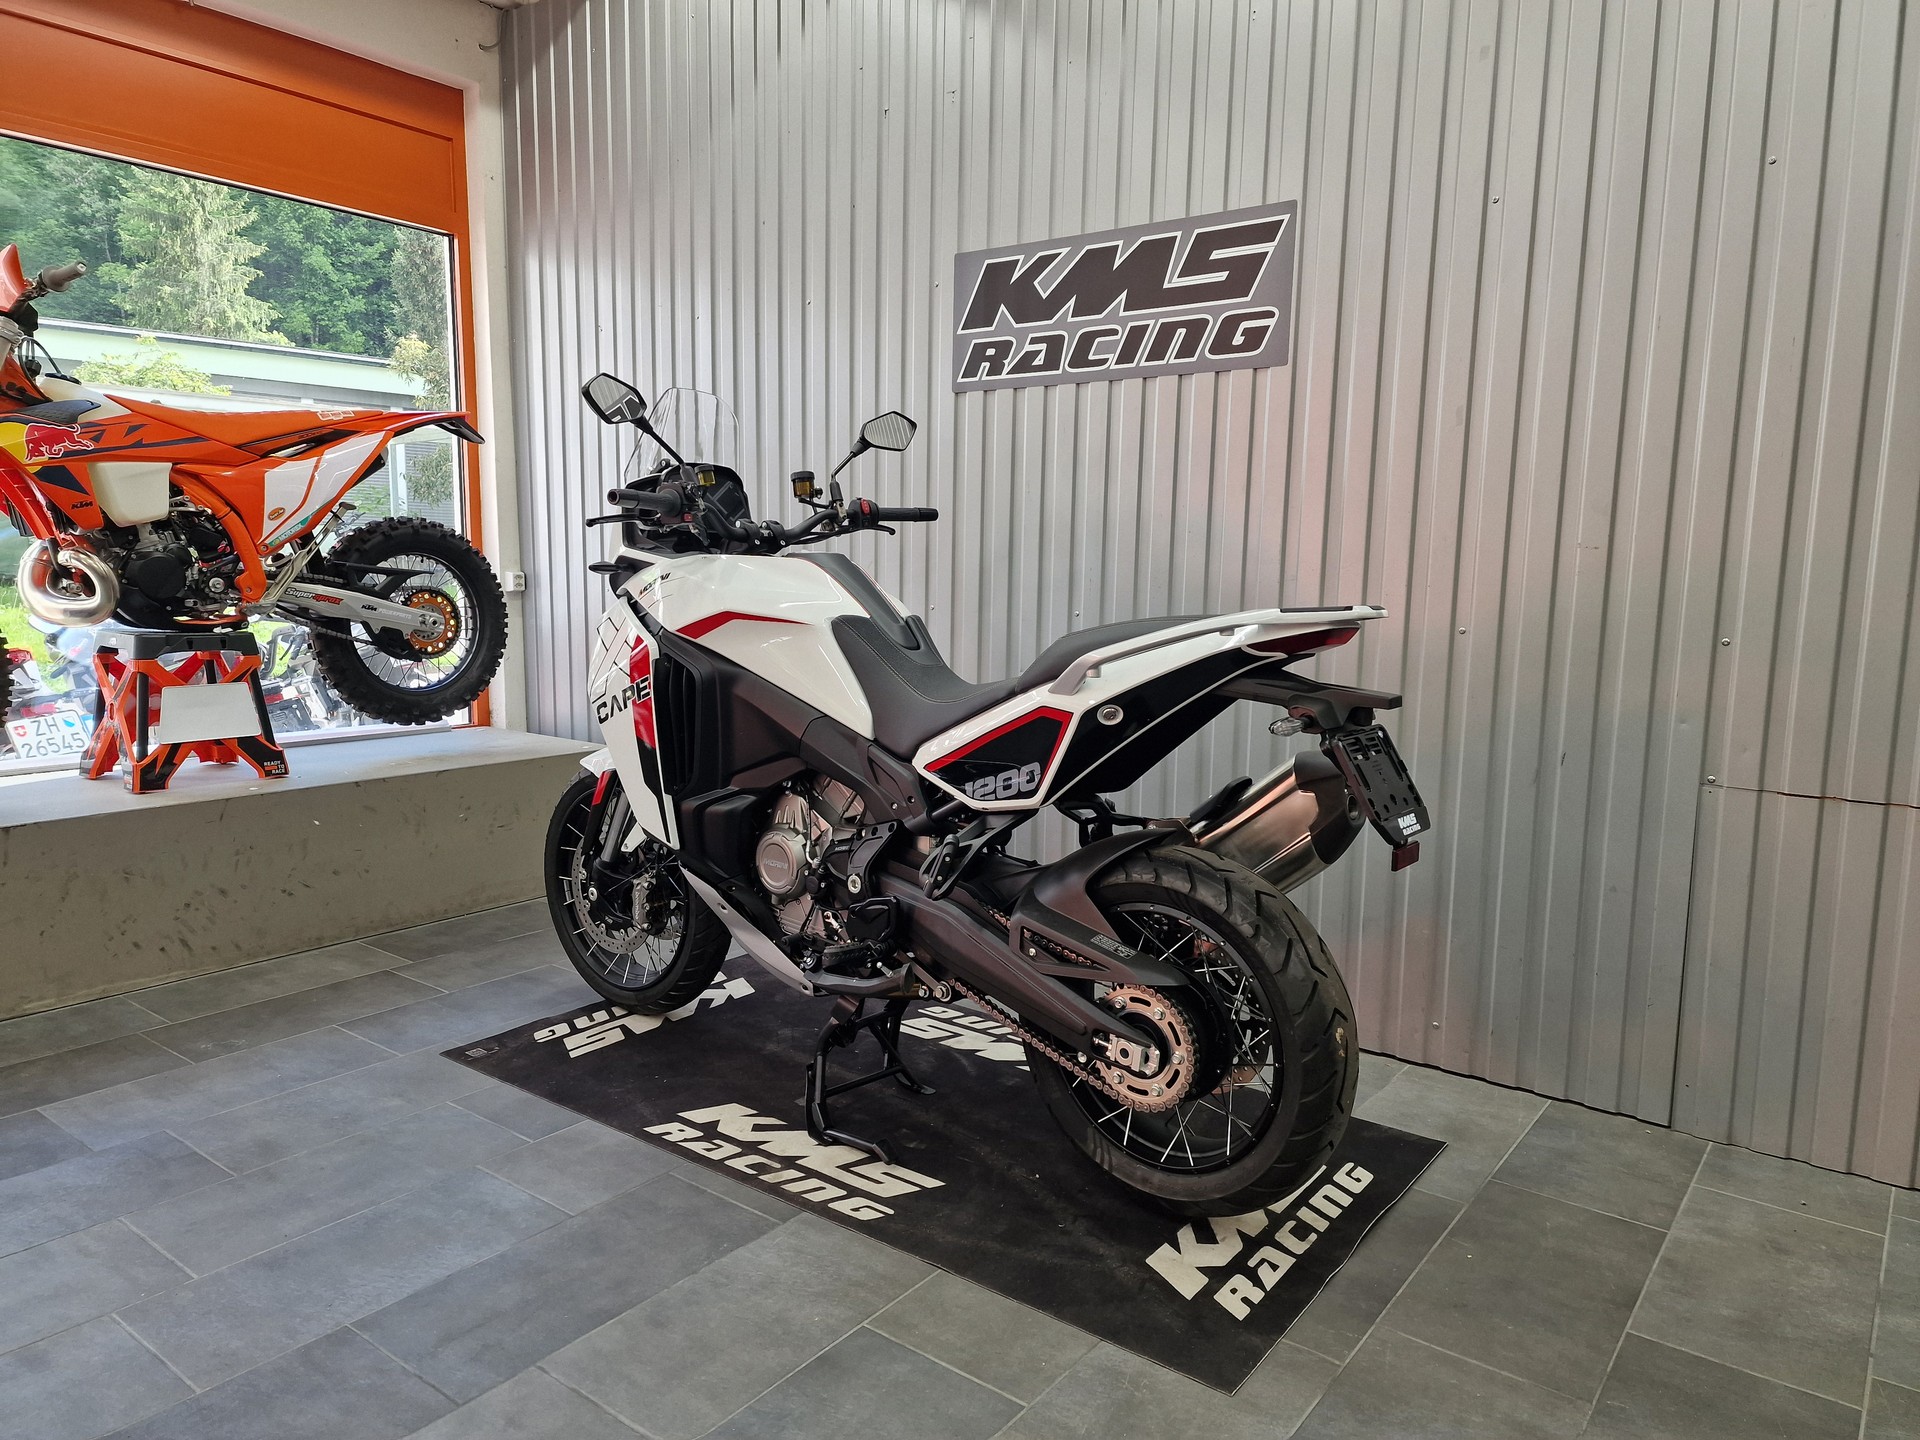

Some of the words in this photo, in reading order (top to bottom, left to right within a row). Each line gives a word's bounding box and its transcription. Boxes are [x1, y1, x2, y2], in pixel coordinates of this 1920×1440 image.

[957, 214, 1291, 334] KMS
[957, 306, 1280, 382] RACING
[71, 501, 94, 510] KTM
[361, 603, 378, 612] KTM
[596, 676, 652, 725] CAPE
[21, 732, 86, 759] 26545
[30, 716, 61, 737] ZH
[965, 762, 1041, 800] 1200
[643, 1122, 895, 1221] RACING
[677, 1102, 946, 1198] KMS
[1213, 1162, 1374, 1321] RACING
